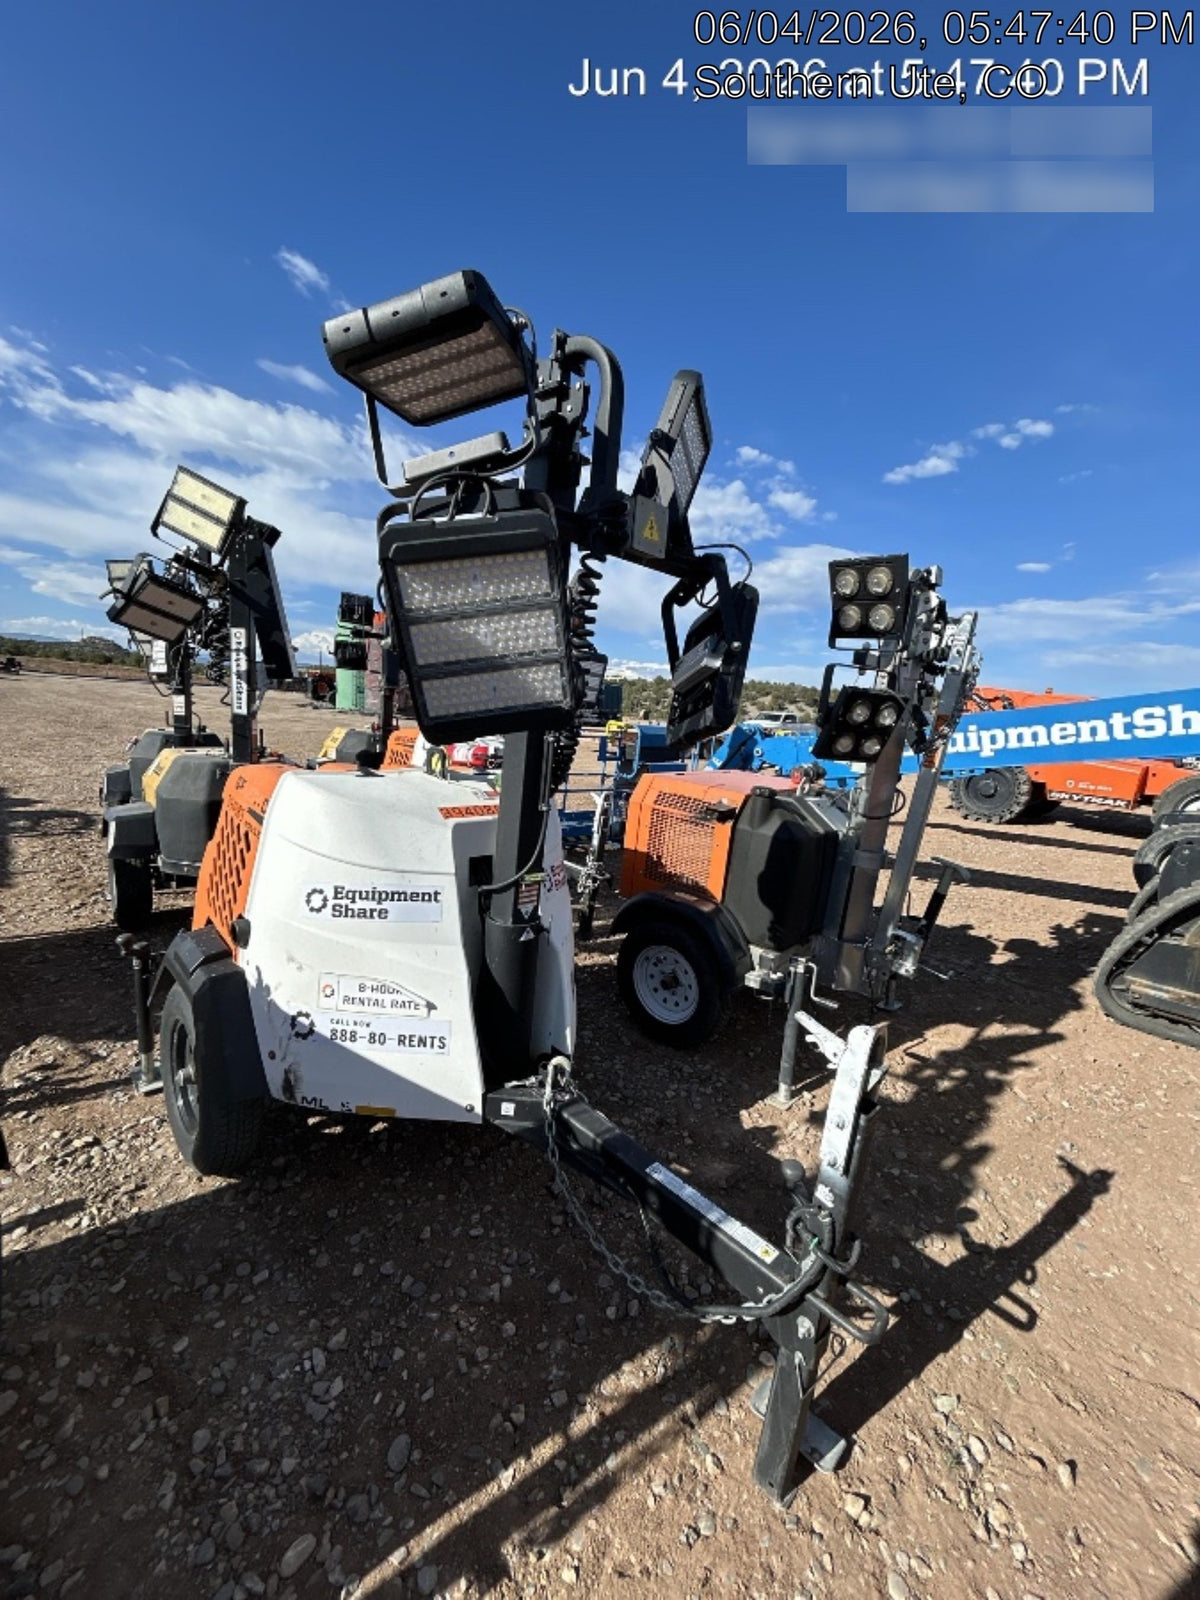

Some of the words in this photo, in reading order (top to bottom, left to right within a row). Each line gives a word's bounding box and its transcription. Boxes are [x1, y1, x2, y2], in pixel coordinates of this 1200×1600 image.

[332, 884, 442, 905] Equipment
[331, 903, 389, 920] Share
[342, 995, 387, 1010] RENTAL
[390, 999, 421, 1011] RATE
[330, 1018, 350, 1027] CALL
[353, 1020, 371, 1029] NOW
[330, 1028, 447, 1050] 888-80-RENTS
